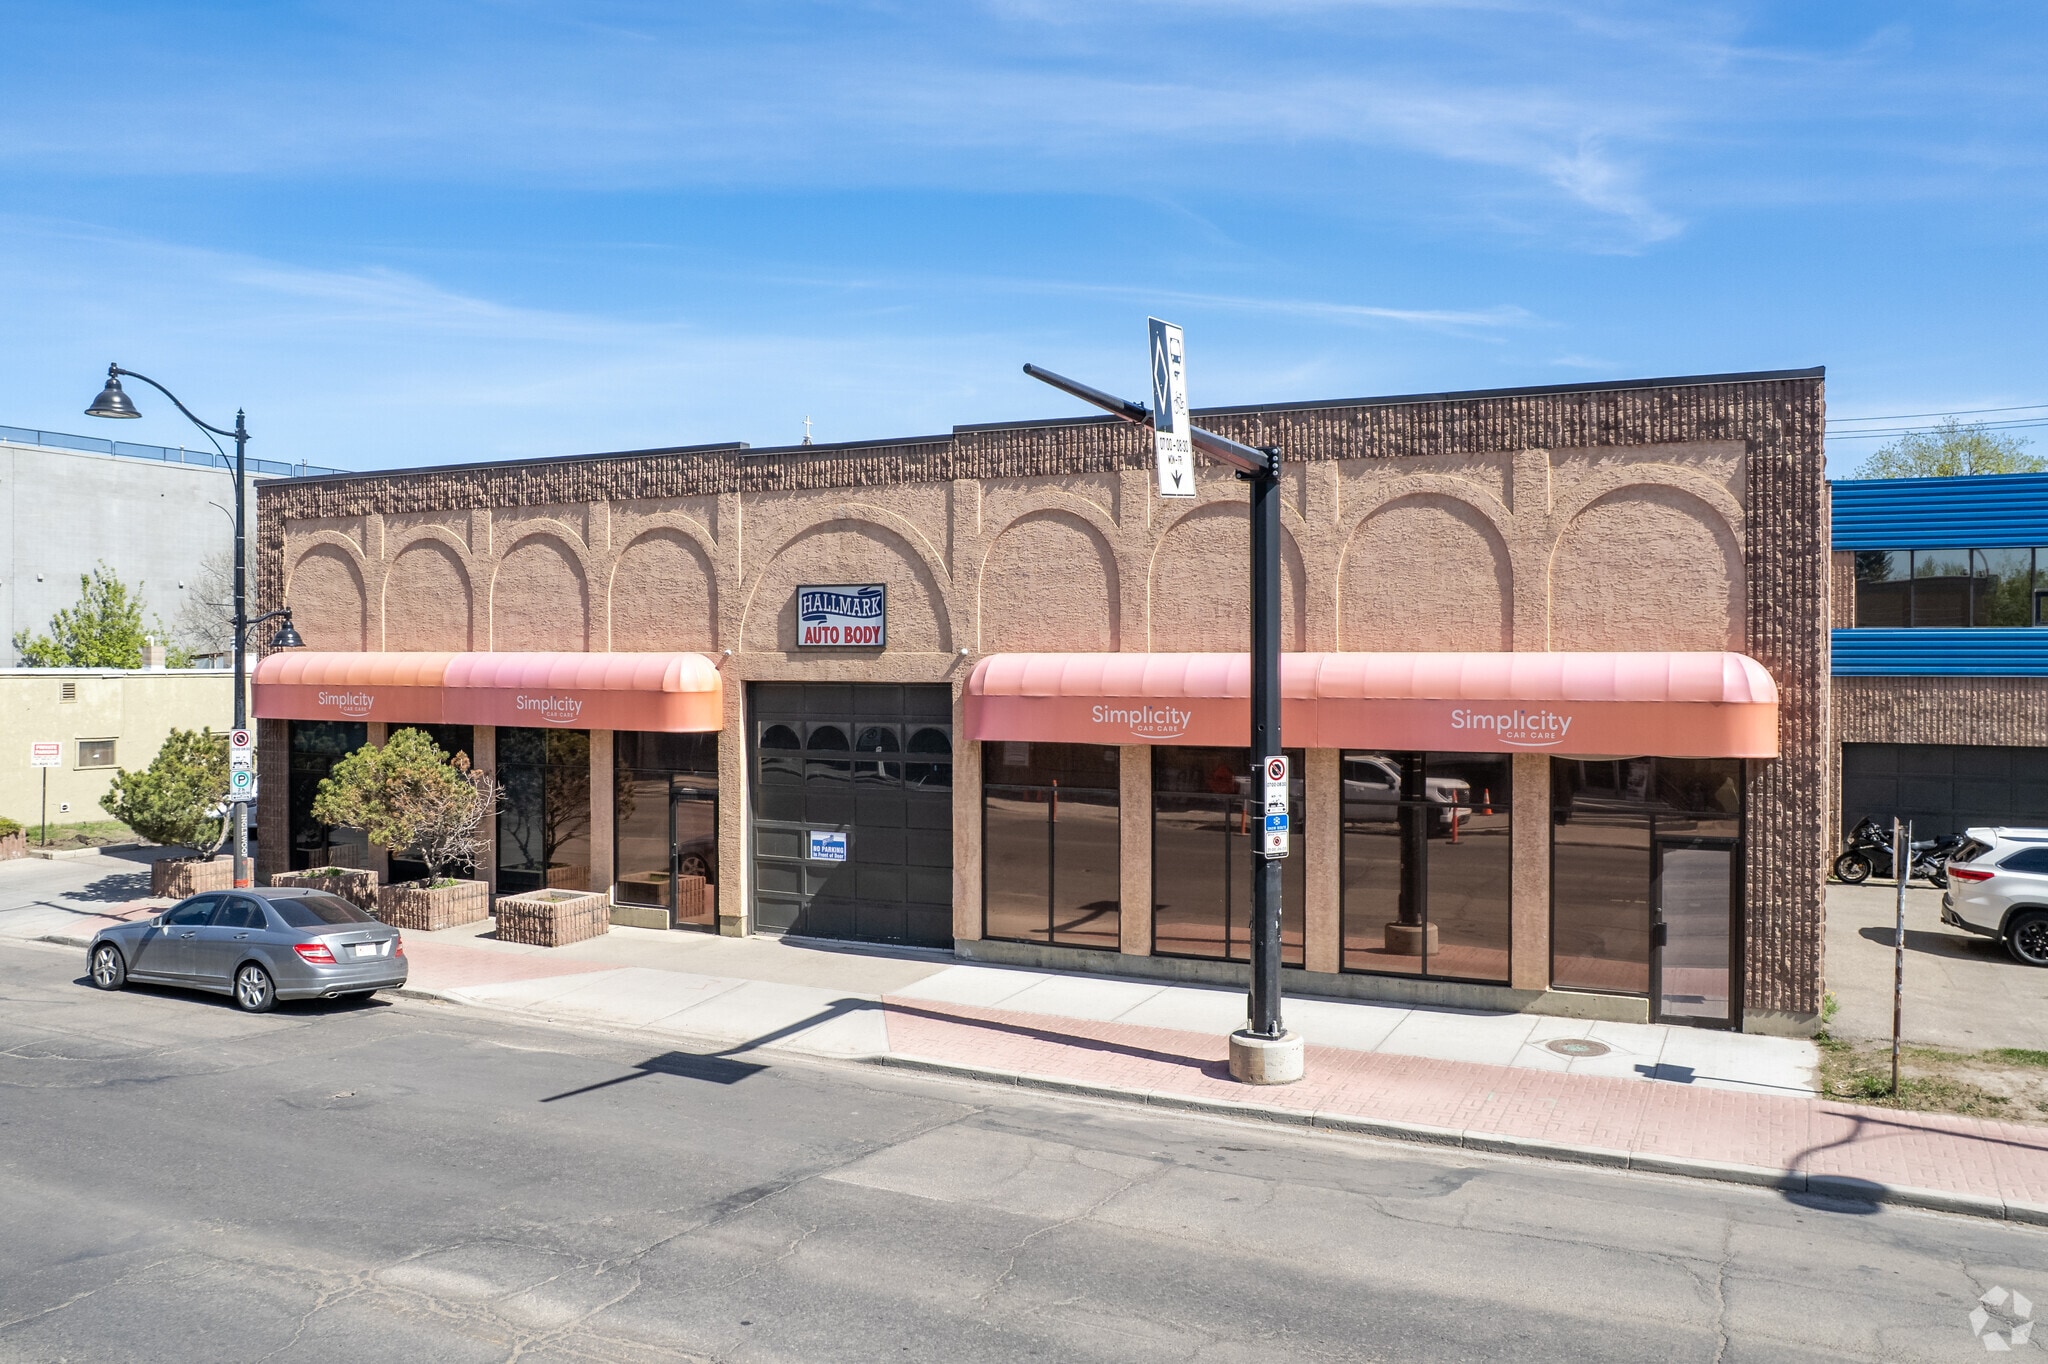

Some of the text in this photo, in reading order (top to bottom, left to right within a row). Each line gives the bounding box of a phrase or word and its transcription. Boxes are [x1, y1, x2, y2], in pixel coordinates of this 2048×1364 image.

[802, 594, 881, 616] HALLMARK
[804, 626, 881, 644] AUTO BODY
[318, 691, 374, 709] Simplicity
[516, 695, 582, 715] Simplicity
[1092, 705, 1192, 729] Simplicity
[1451, 709, 1572, 736] Simplicity
[238, 774, 246, 784] P
[821, 846, 844, 854] PARKING
